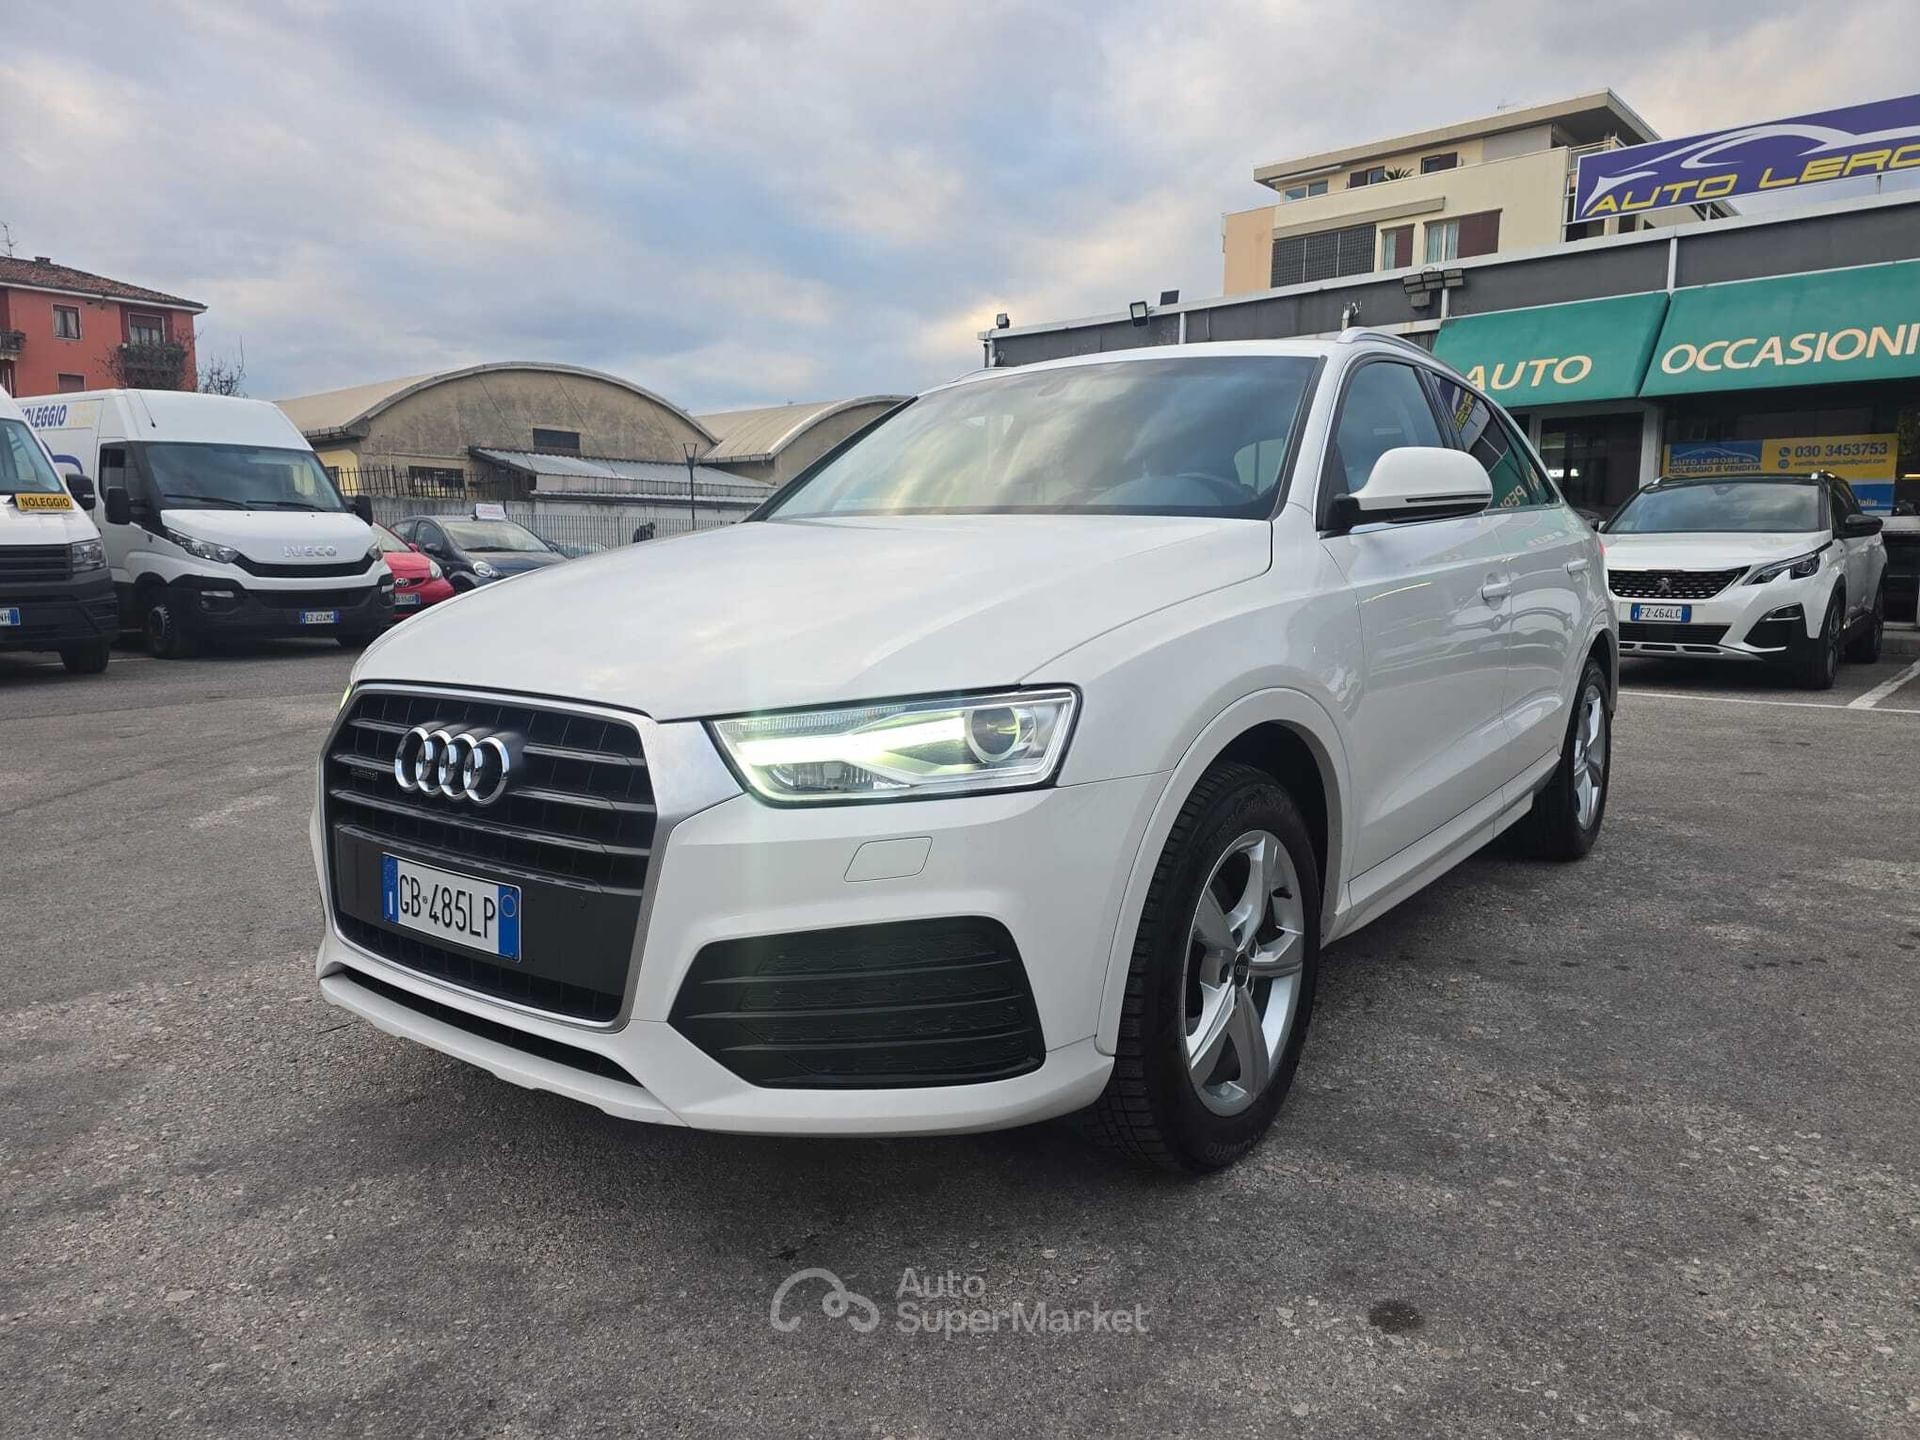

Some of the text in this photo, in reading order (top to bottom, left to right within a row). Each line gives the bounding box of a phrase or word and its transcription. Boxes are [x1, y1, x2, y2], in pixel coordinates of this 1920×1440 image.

[1587, 174, 1738, 217] AUTO
[1466, 323, 1920, 391] AUTO OCCASIONI
[22, 404, 67, 428] OLEGGIO
[1794, 443, 1888, 457] 030 3453753
[20, 497, 70, 507] NOLEGGIO
[284, 546, 337, 557] IVECO
